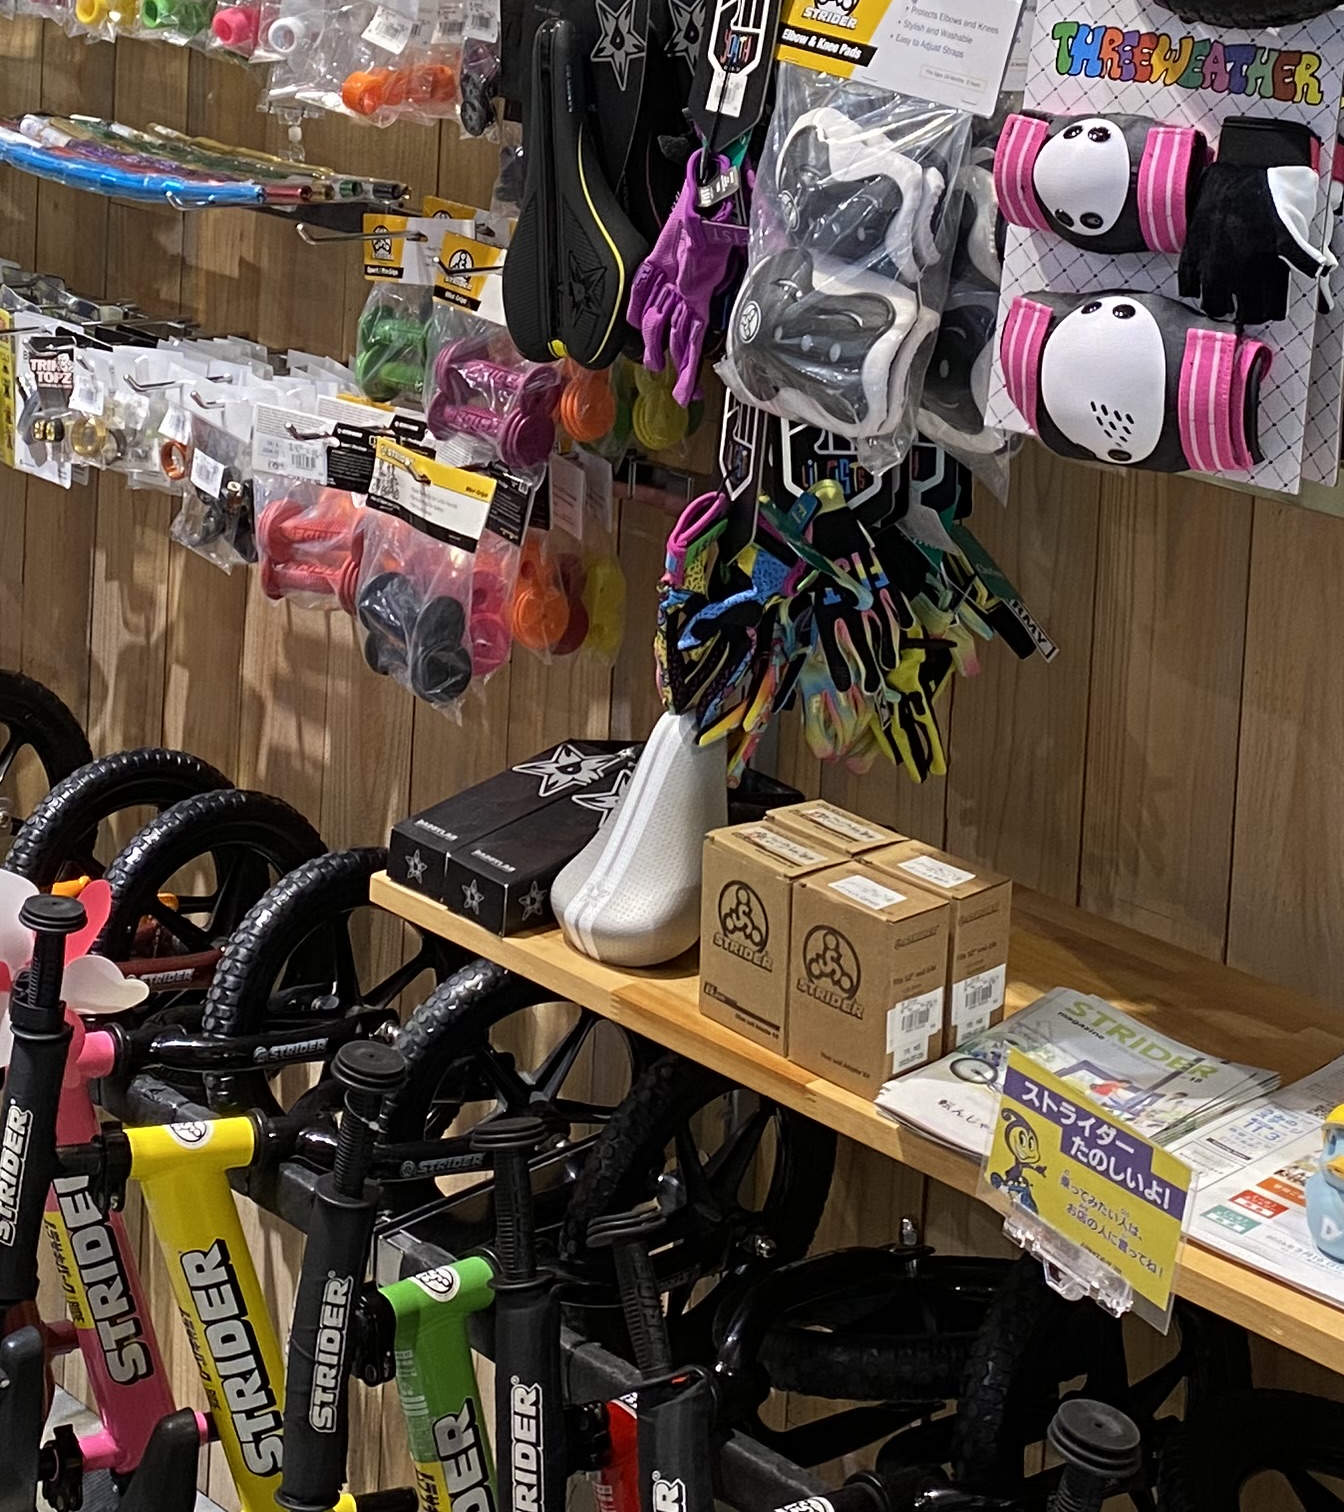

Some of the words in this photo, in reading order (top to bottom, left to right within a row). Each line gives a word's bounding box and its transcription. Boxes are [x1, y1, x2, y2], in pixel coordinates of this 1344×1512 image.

[803, 6, 858, 30] STRIDER
[903, 20, 923, 35] Stylish
[926, 25, 939, 36] and
[940, 28, 973, 45] Washable
[911, 7, 937, 20] Protects
[939, 12, 962, 25] Elbows
[964, 17, 976, 27] and
[977, 20, 999, 35] Knees
[782, 29, 807, 45] Elbow
[808, 36, 816, 47] &
[817, 39, 838, 53] Knee
[839, 43, 861, 59] Pads
[895, 34, 911, 47] Easy
[912, 38, 920, 48] to
[921, 40, 941, 54] Adjust
[942, 44, 964, 59] Straps
[1051, 20, 1324, 106] THREEWEATHER
[35, 371, 73, 386] TOPZ
[713, 930, 774, 973] STRIDER
[796, 976, 864, 1020] STRIDER
[1057, 1010, 1105, 1041] magazine
[1064, 1000, 1219, 1080] STRIDER
[266, 1038, 330, 1062] STRIDER
[1021, 1080, 1136, 1155] ストライダー
[415, 1154, 486, 1178] STRIDER
[1070, 1134, 1172, 1211] たのしいよ!
[1060, 1176, 1144, 1242] 乗ってみたい人は、
[1066, 1202, 1165, 1279] お店の人に言ってね!
[53, 1175, 155, 1386] STRIDE
[178, 1238, 286, 1478] STRIDER
[308, 1270, 355, 1434] STRIDER
[510, 1383, 544, 1512] RIDER
